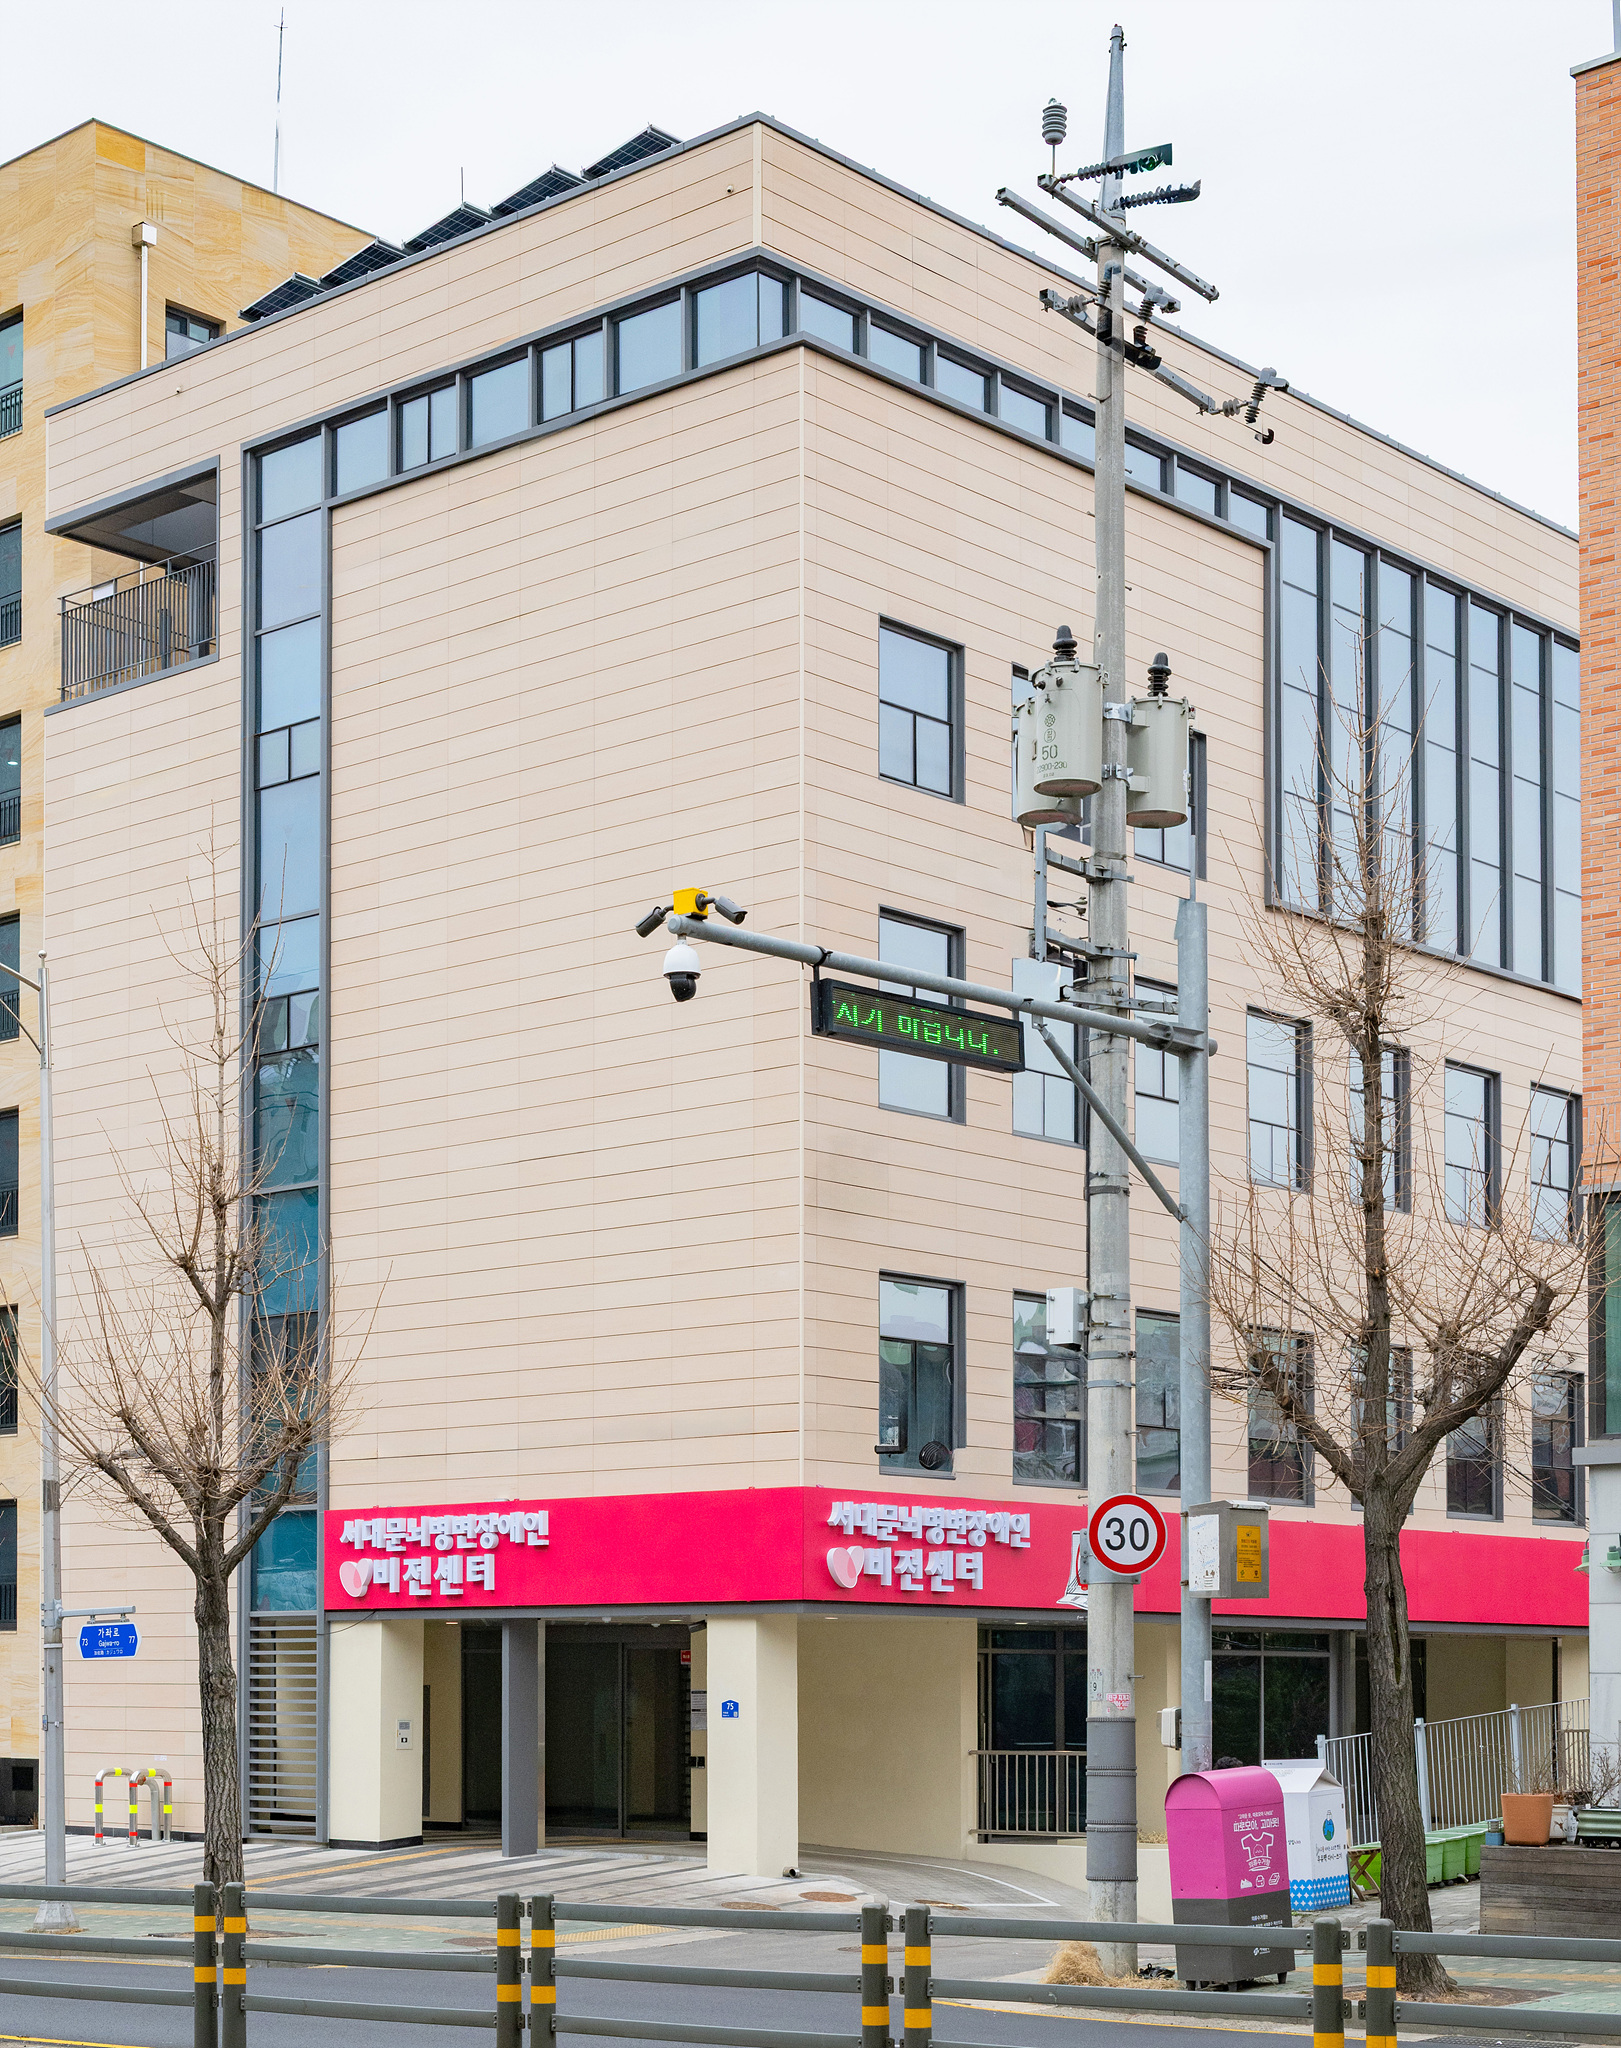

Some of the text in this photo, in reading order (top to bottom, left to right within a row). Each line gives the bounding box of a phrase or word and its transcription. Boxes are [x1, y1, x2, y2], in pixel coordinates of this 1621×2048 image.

[1042, 744, 1058, 761] 50
[1104, 1517, 1149, 1552] 30
[373, 1553, 496, 1596] 비전센터
[863, 1546, 984, 1592] 비전센터
[97, 1627, 120, 1639] 가좌로
[128, 1635, 136, 1644] 77
[81, 1638, 89, 1647] 73
[726, 1702, 734, 1711] 75
